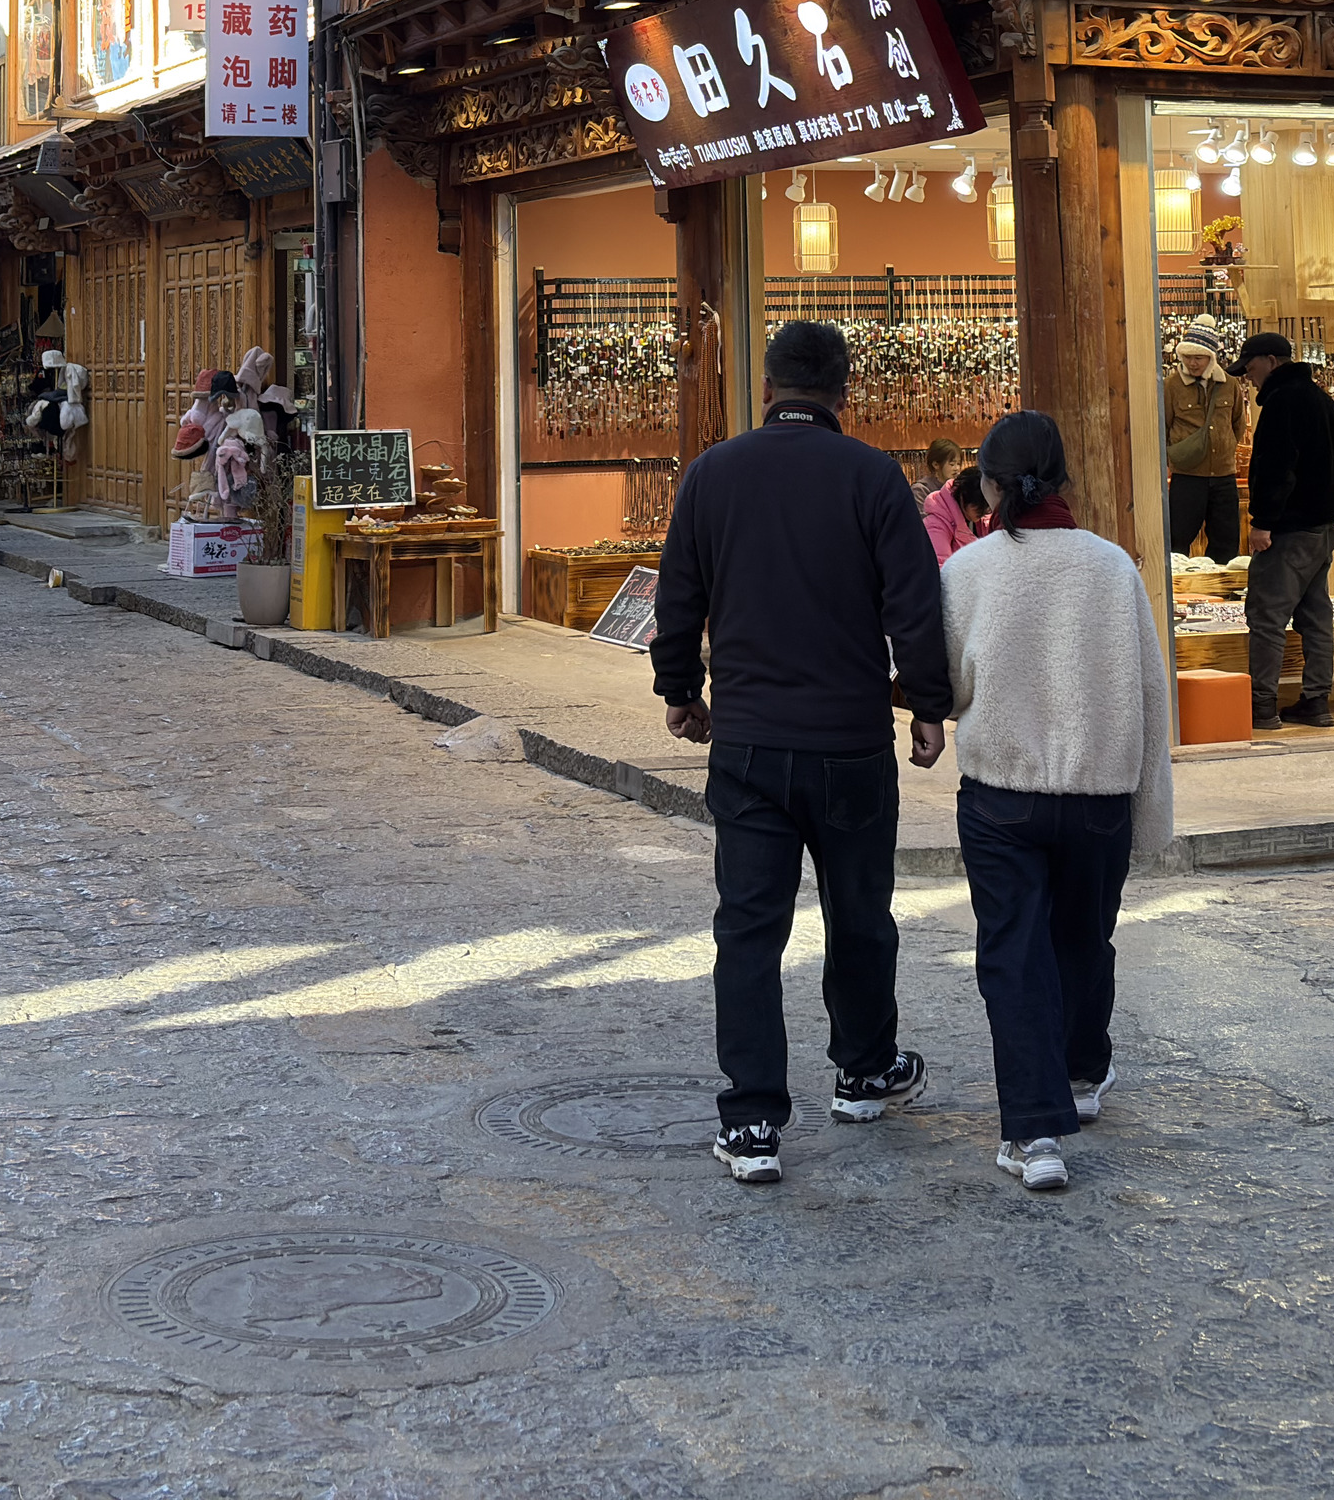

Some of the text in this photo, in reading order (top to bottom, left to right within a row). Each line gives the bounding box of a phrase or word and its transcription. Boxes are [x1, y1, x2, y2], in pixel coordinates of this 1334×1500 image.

[222, 3, 298, 38] 藏药
[222, 55, 297, 89] 泡脚
[221, 103, 298, 125] 请上二楼
[694, 134, 752, 164] TIANJIUSHI
[755, 123, 797, 151] 独家原创
[795, 112, 843, 143] 真材实料
[843, 104, 881, 132] 工厂价
[882, 93, 935, 125] 仅此一家
[779, 411, 814, 422] Canon
